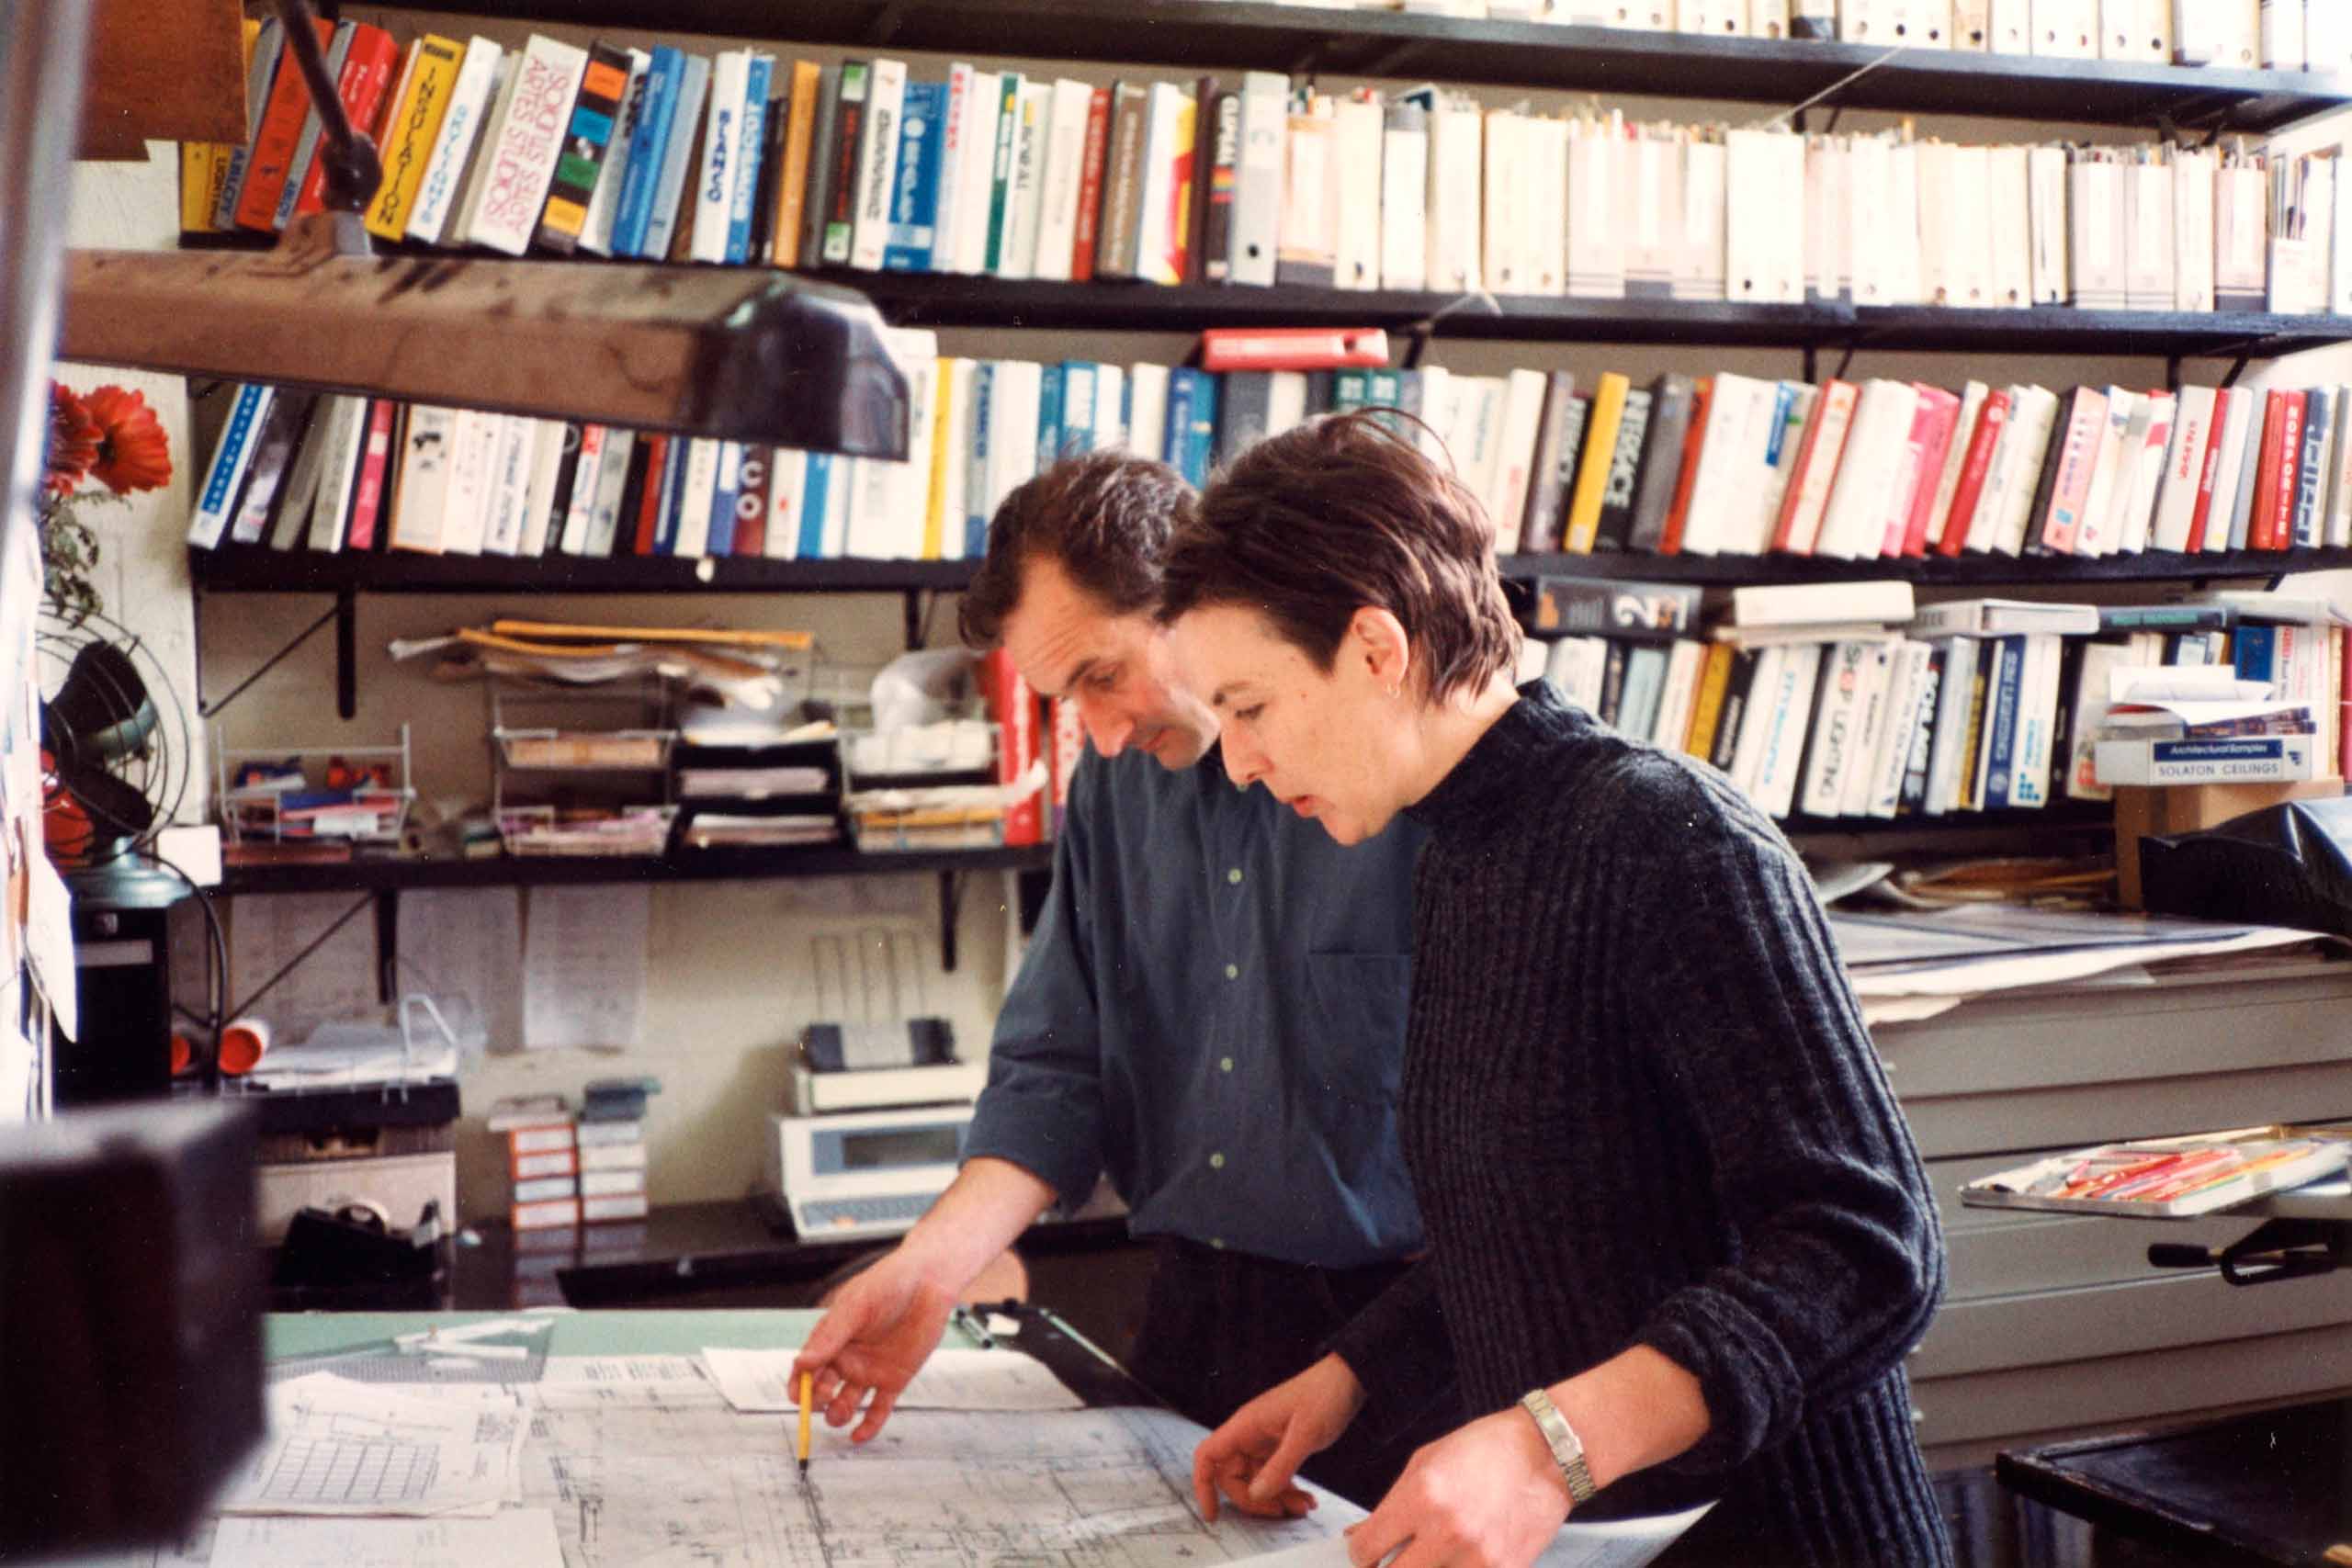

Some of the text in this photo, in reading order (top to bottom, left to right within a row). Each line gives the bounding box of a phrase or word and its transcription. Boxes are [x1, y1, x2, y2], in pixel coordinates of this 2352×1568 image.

[379, 66, 438, 226] INSULATION
[2159, 763, 2278, 777] SOLATON CEILINGS
